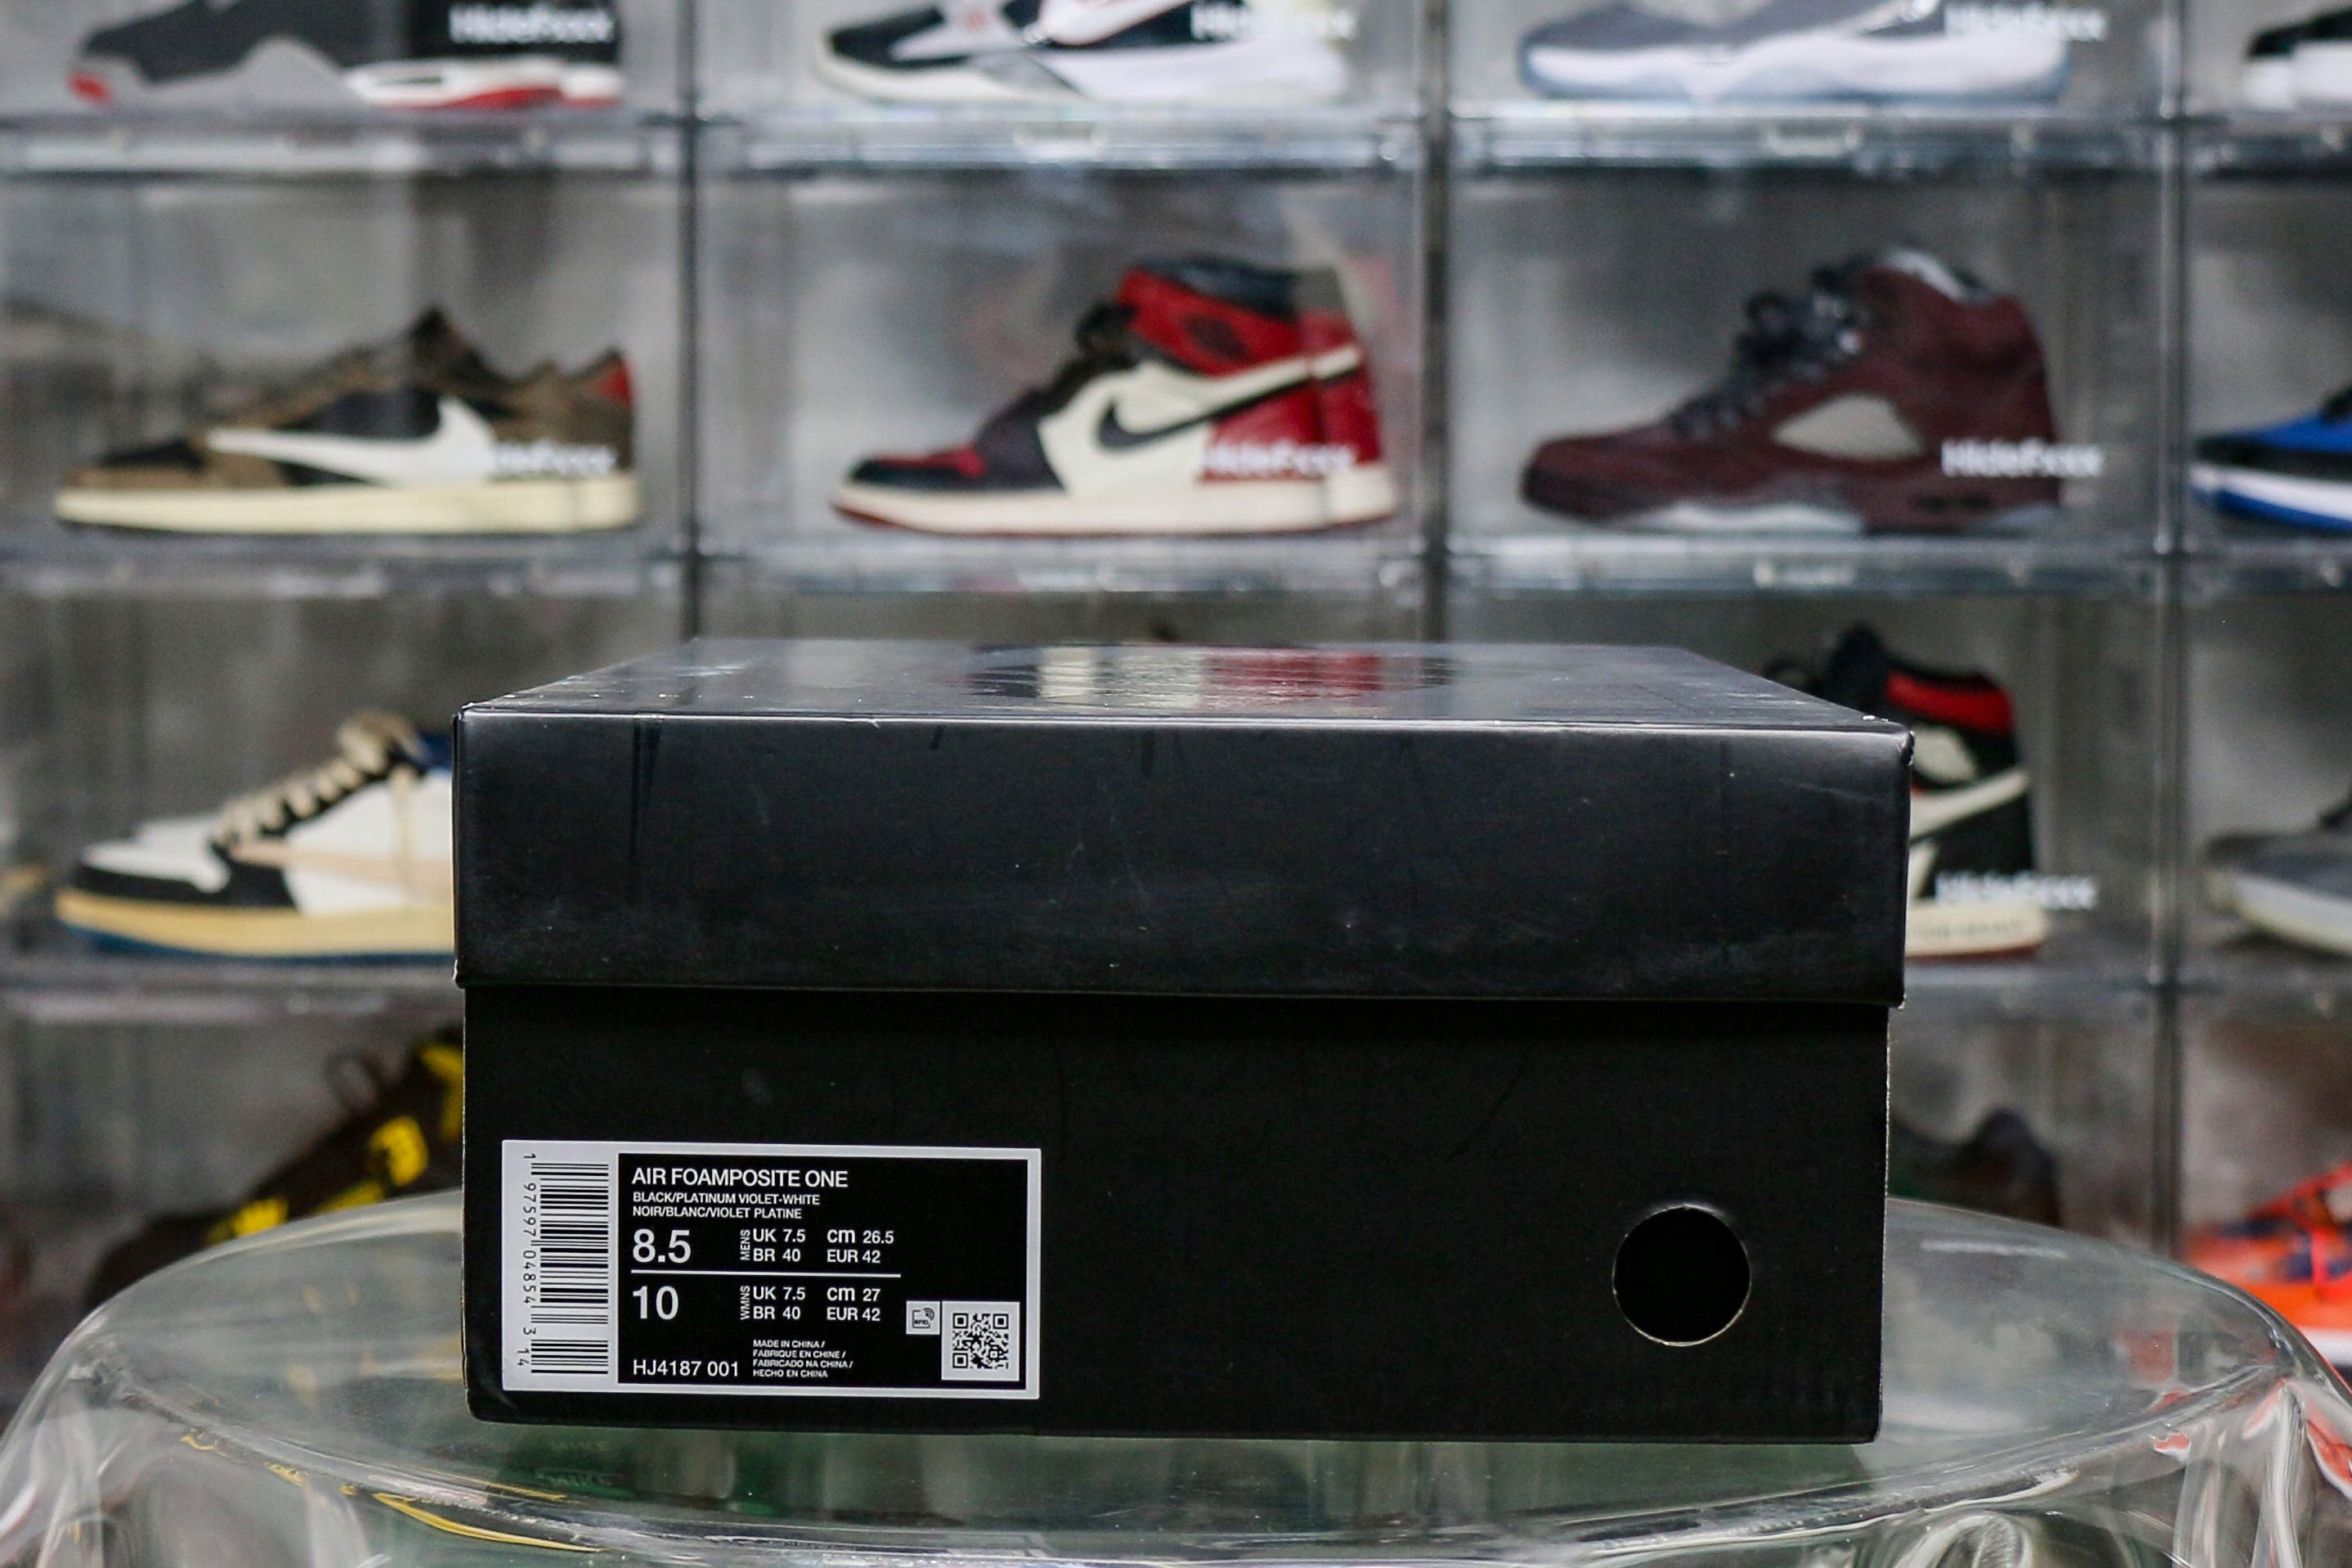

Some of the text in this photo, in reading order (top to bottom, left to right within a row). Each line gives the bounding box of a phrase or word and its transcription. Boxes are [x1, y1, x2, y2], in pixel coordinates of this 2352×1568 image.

[631, 1167, 849, 1187] AIR FOAMPOSITE ONE
[633, 1192, 820, 1205] BLACK/PLATINUM VIOLET-WHITE
[523, 1182, 537, 1237] 97597
[633, 1206, 802, 1219] NOIR/BLANC/VIOLET PLATINE
[753, 1228, 894, 1244] UK 7.5 cm 26.5
[633, 1228, 692, 1264] 8.5
[740, 1229, 750, 1261] MENS
[753, 1248, 881, 1264] BR 40 EUR 42
[523, 1250, 537, 1304] 04854
[753, 1286, 881, 1302] UK 7.5 cm 27
[633, 1286, 679, 1320] 10
[740, 1285, 750, 1320] WMNS
[753, 1305, 881, 1322] BR 40 EUR 42
[523, 1327, 537, 1336] 3
[753, 1340, 779, 1348] MADE
[781, 1340, 791, 1349] IN
[516, 1348, 530, 1367] 14
[753, 1349, 797, 1358] FABRIQUE
[799, 1350, 811, 1358] EN
[813, 1350, 840, 1358] CHINE
[633, 1359, 738, 1377] HJ4187 001
[753, 1359, 804, 1368] FABRICADO
[805, 1360, 818, 1368] NA
[753, 1369, 784, 1377] HECHO
[800, 1370, 828, 1378] CHINA
